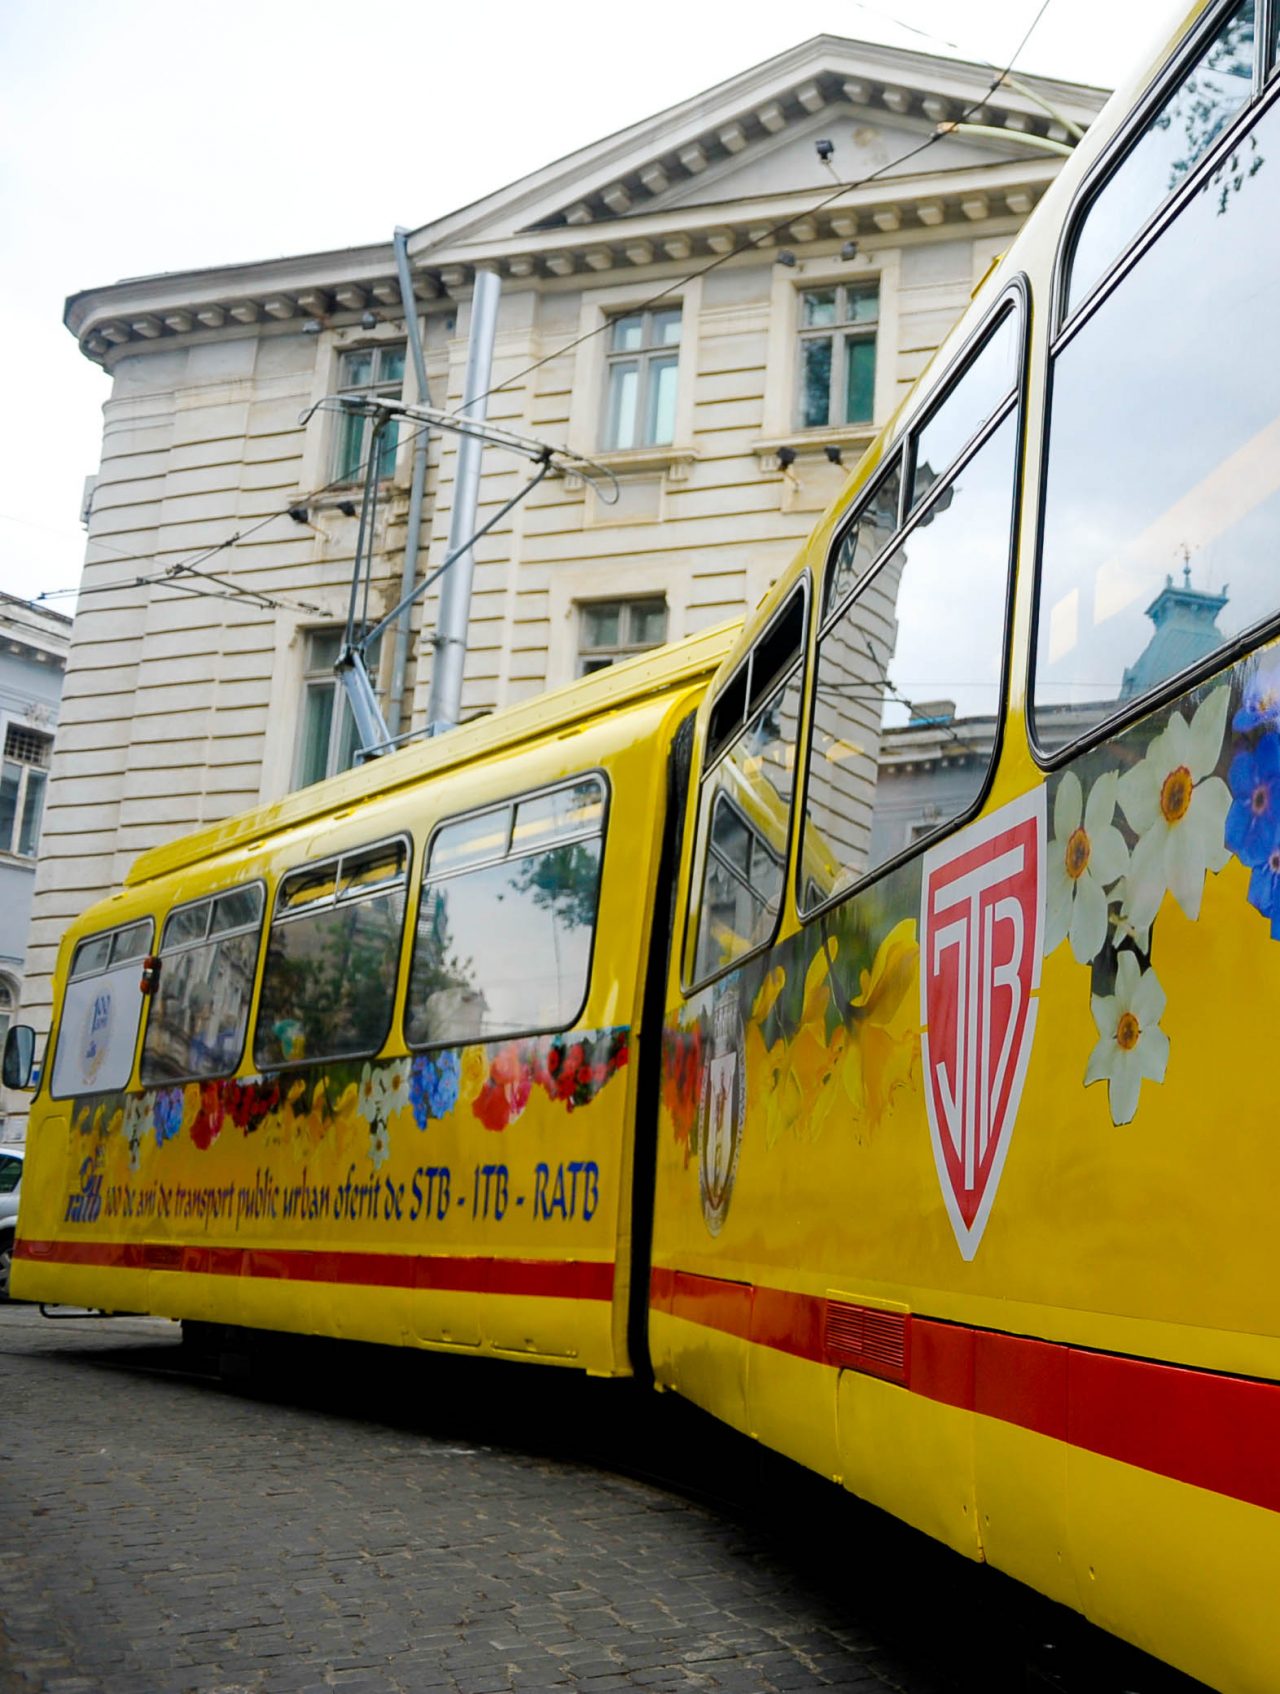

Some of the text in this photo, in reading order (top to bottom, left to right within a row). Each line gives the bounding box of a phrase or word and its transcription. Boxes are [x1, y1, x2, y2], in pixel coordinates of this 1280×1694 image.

[157, 1182, 173, 1218] de
[175, 1180, 235, 1232] transport
[235, 1167, 280, 1232] public
[283, 1167, 330, 1220] urban
[333, 1162, 381, 1220] oferit
[384, 1173, 405, 1221] de
[409, 1166, 451, 1221] STB
[472, 1162, 509, 1222] ITB
[532, 1161, 599, 1222] RATB
